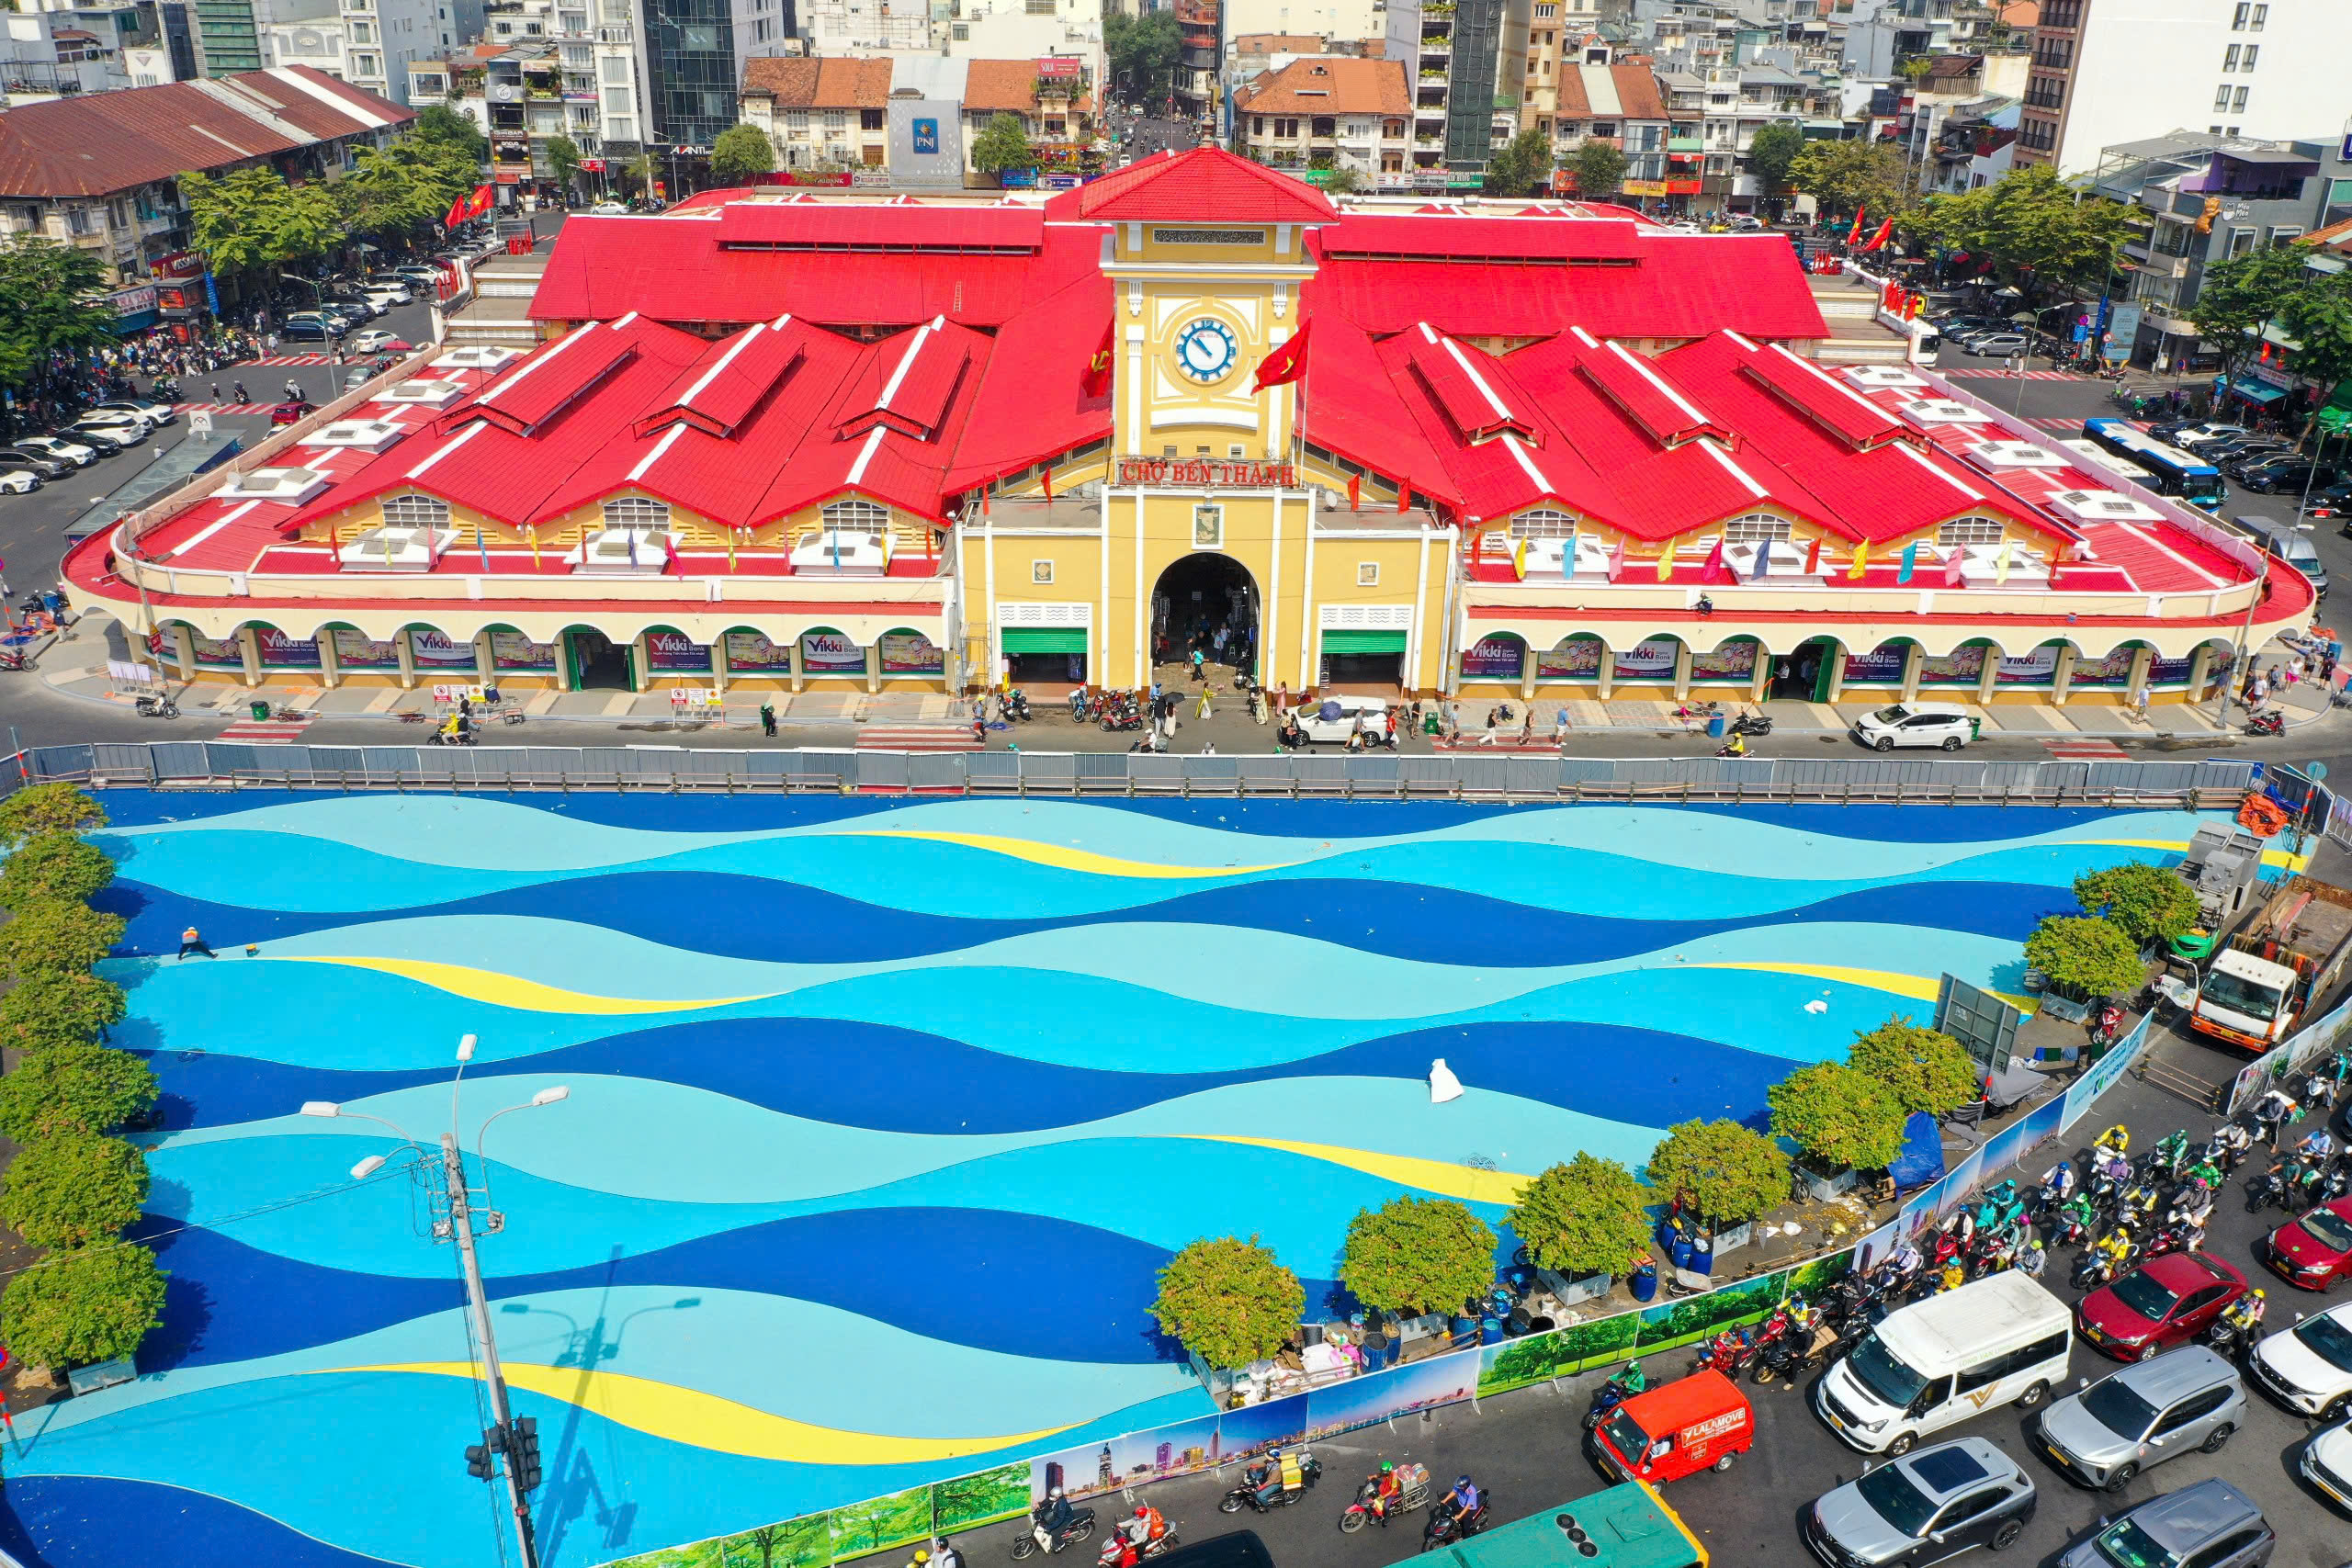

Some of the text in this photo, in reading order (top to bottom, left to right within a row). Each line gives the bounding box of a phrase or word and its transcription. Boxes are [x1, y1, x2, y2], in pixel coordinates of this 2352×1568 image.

[670, 146, 705, 154] AVANTI
[917, 137, 934, 150] PNJ
[1172, 458, 1213, 482] BẾN
[651, 634, 688, 651] Vikki
[808, 634, 842, 652] Vikki
[1470, 638, 1501, 658] Vikki
[1693, 1409, 1745, 1437] LALAMOVE
